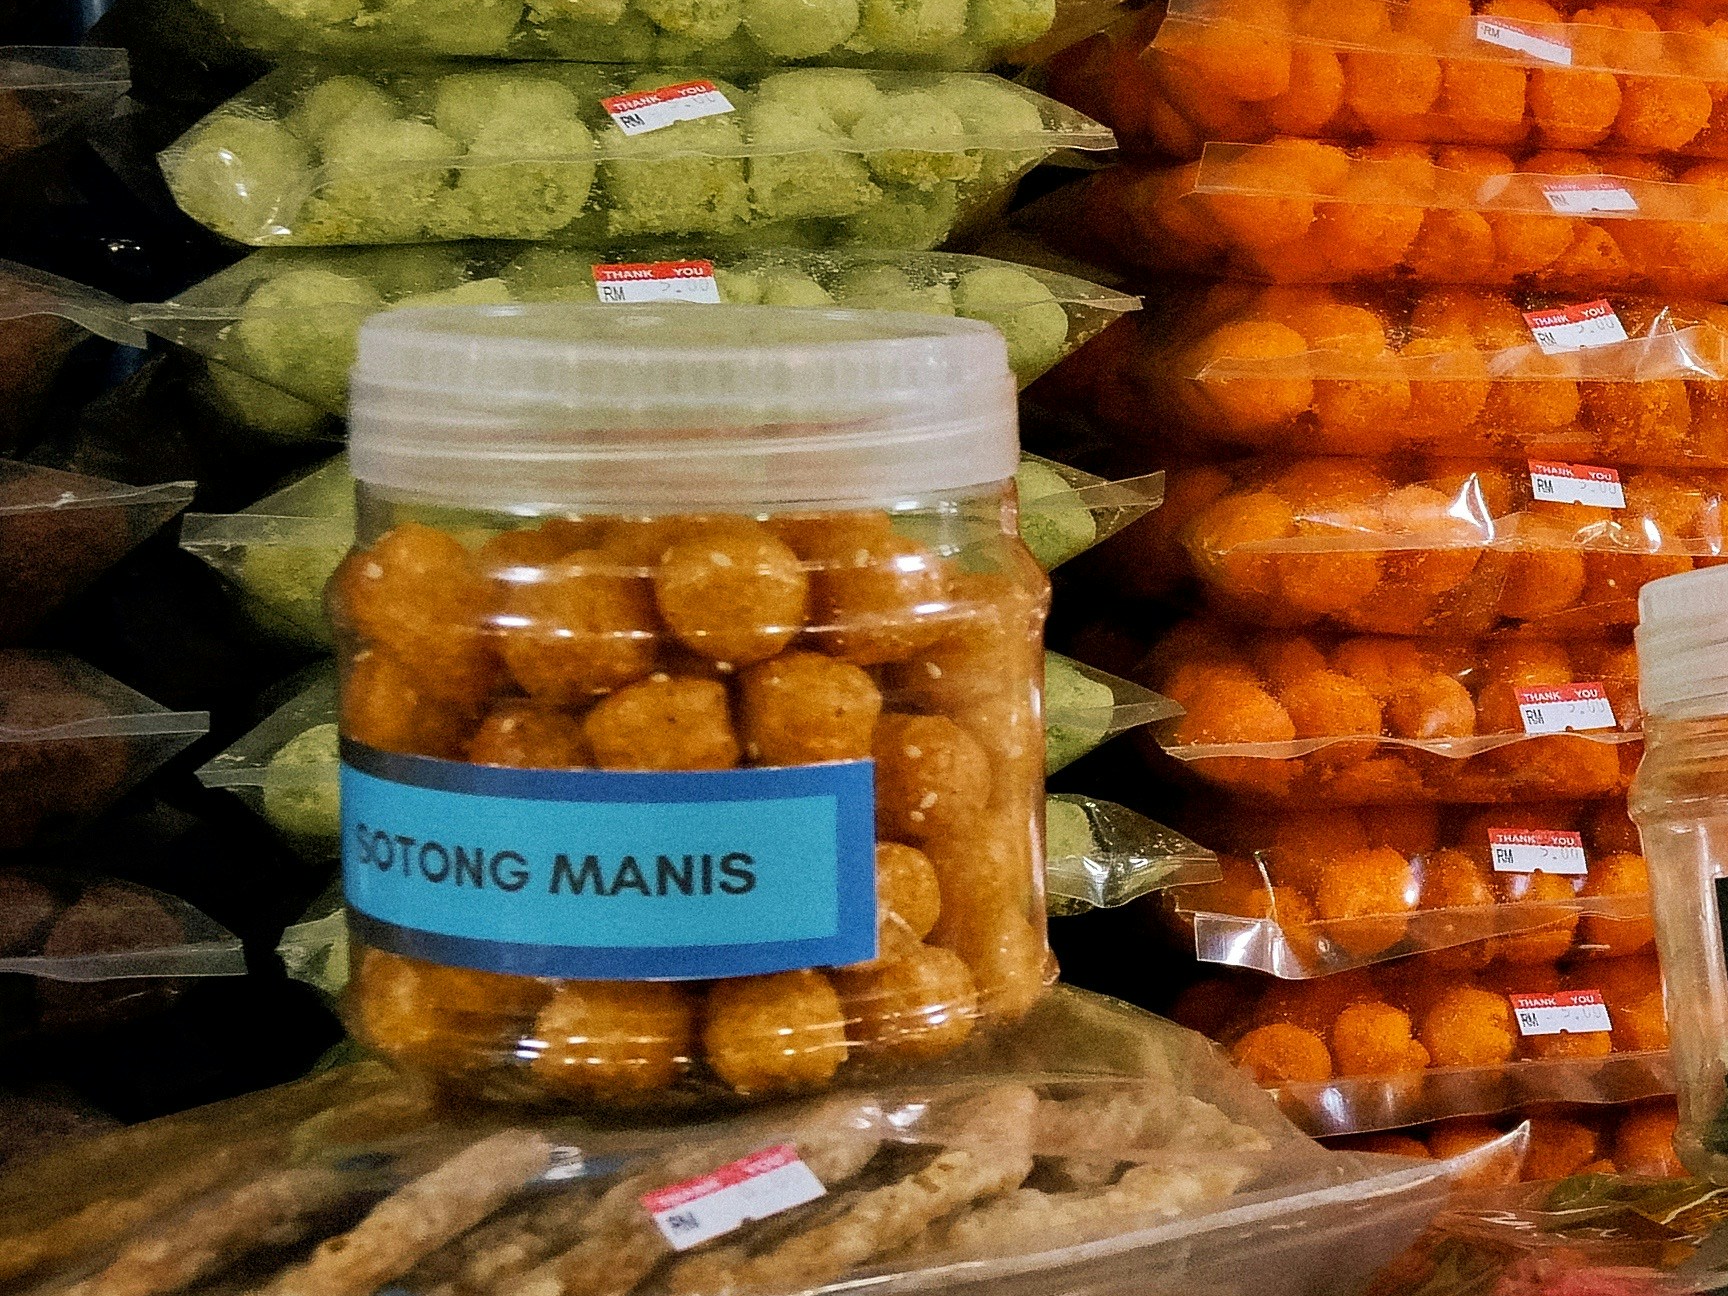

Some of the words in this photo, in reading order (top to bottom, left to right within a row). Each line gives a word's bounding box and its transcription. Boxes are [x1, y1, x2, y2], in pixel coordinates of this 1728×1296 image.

[612, 94, 660, 111] THANK
[677, 84, 707, 98] YOU
[620, 112, 645, 128] RM
[601, 269, 653, 280] THANK
[672, 267, 704, 277] YOU
[603, 286, 625, 301] RM
[1531, 314, 1569, 326] THANK
[1582, 306, 1606, 318] YOU
[1535, 465, 1575, 477] THANK
[1589, 471, 1612, 481] YOU
[1537, 478, 1554, 494] RM
[1522, 691, 1561, 702] THANK
[1574, 688, 1598, 699] YOU
[1525, 708, 1545, 725] RM
[1496, 834, 1537, 844] THANK
[1550, 836, 1575, 846] YOU
[353, 823, 530, 893] SOTONG
[548, 851, 757, 896] MANIS
[1496, 848, 1514, 864] RM
[1518, 997, 1557, 1008] THANK
[1569, 994, 1595, 1004] YOU
[1520, 1012, 1540, 1027] RM
